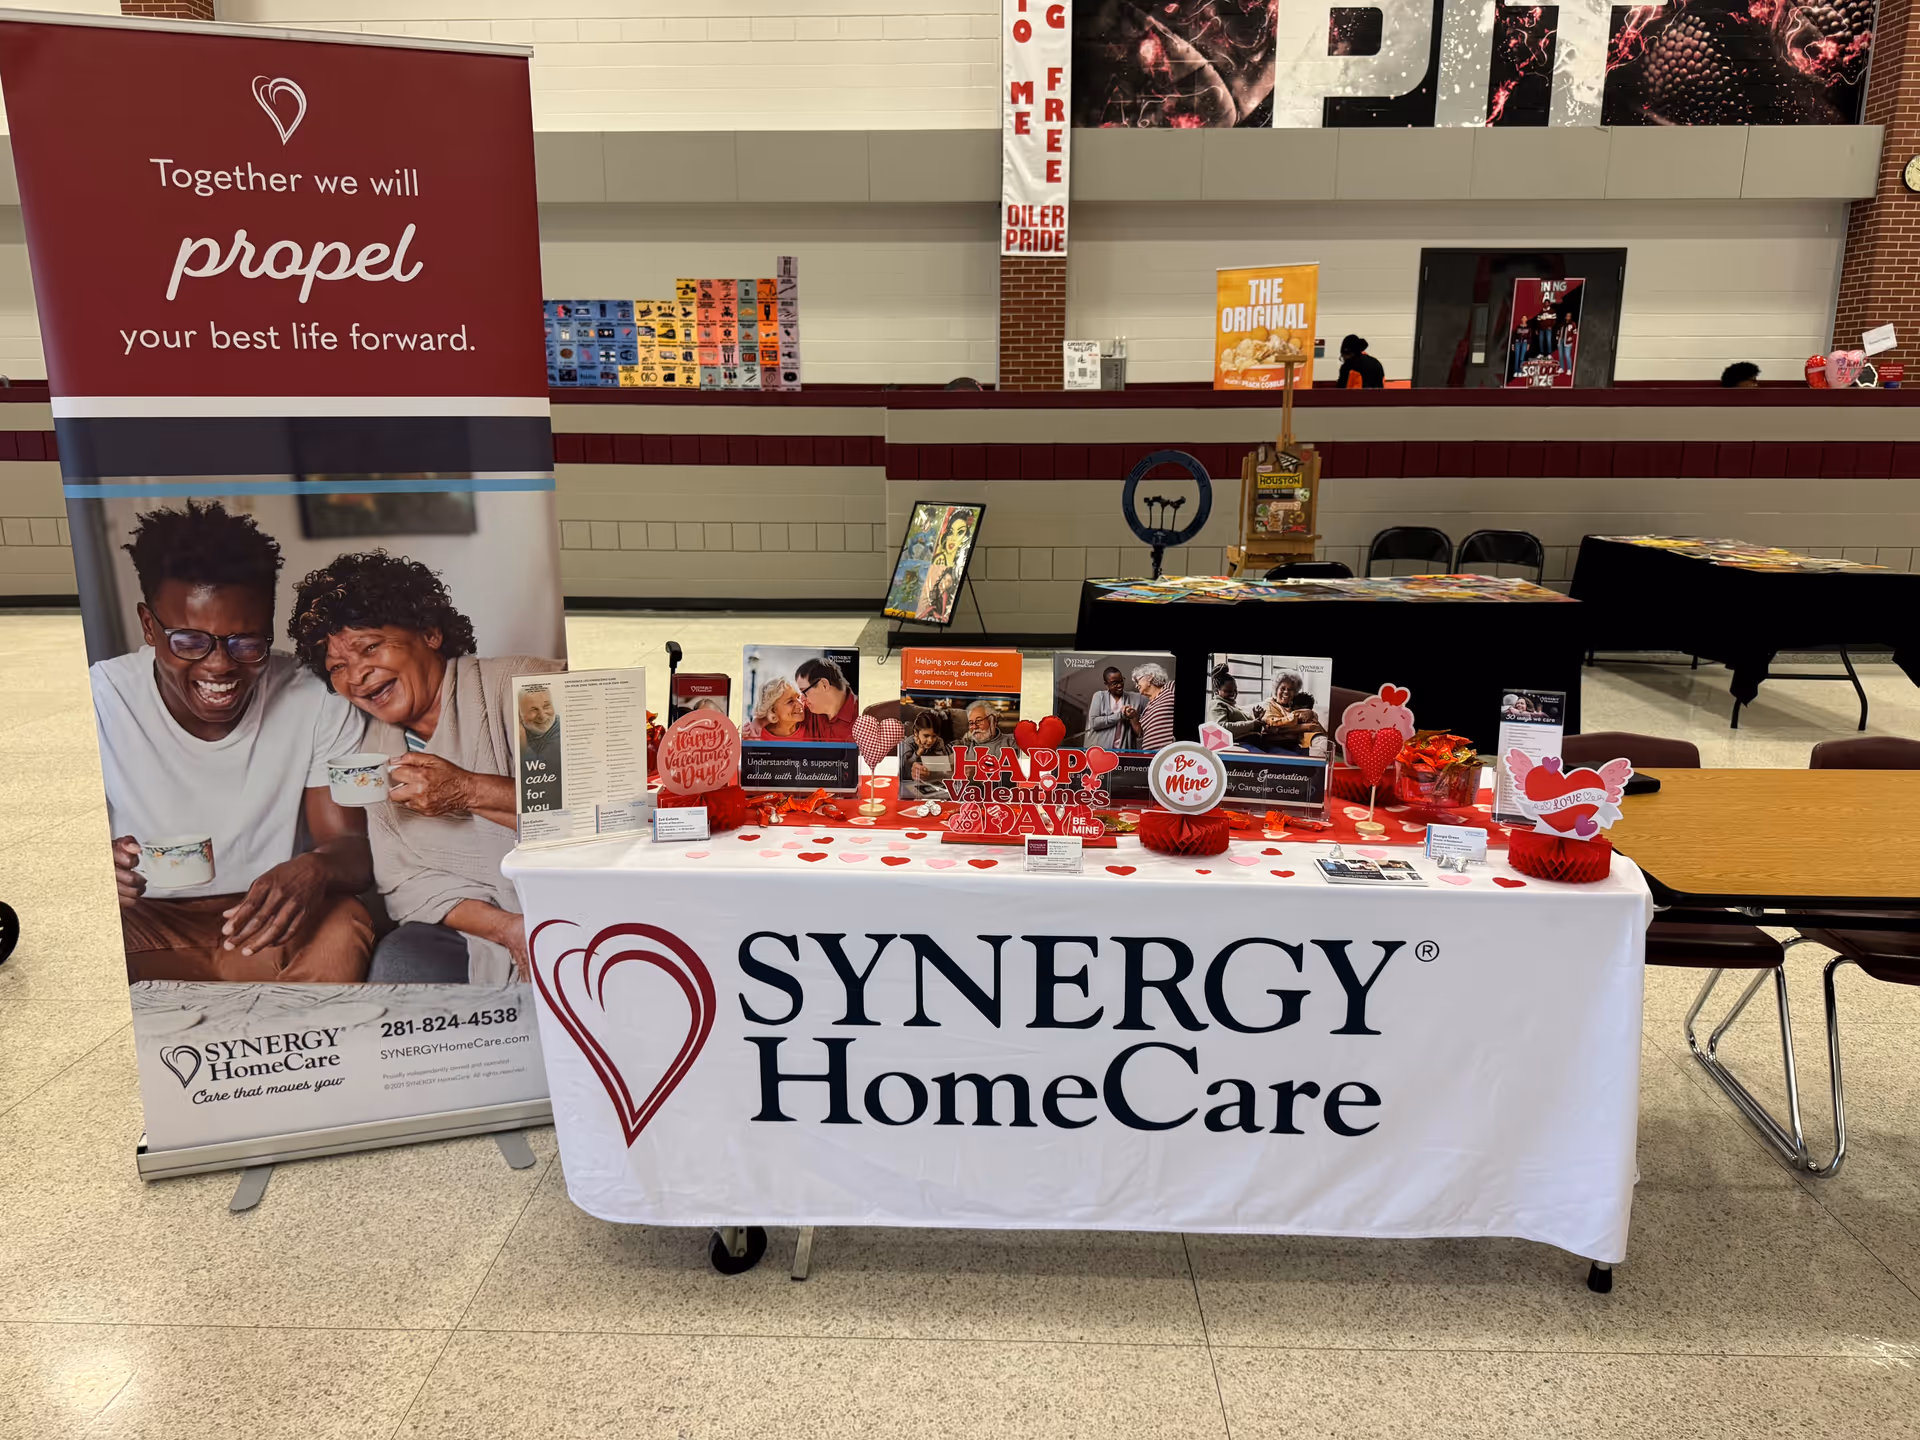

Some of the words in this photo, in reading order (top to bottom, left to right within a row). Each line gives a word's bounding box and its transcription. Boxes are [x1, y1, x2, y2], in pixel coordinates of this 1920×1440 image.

[1045, 67, 1065, 183] FREE
[150, 159, 303, 197] Together
[314, 175, 358, 195] we
[370, 168, 419, 197] will
[1007, 204, 1065, 228] OILER
[1005, 229, 1065, 253] PRIDE
[166, 223, 424, 304] propel
[1248, 278, 1283, 306] THE
[1221, 303, 1308, 333] ORIGINAL
[119, 329, 198, 355] your
[210, 321, 281, 350] best
[291, 322, 338, 350] life
[350, 322, 476, 351] forward.
[1260, 475, 1300, 486] HOUSTON
[915, 656, 942, 666] Helping
[943, 659, 959, 667] your
[960, 658, 982, 667] loved
[914, 668, 959, 677] experiencing
[960, 669, 993, 678] dementia
[954, 679, 968, 687] loss
[525, 760, 546, 771] We
[747, 758, 800, 768] Understanding
[802, 759, 808, 767] &
[810, 759, 849, 769] supporting
[1174, 754, 1197, 772] Be
[525, 773, 557, 784] care
[746, 772, 772, 780] adults
[774, 772, 792, 780] with
[794, 772, 838, 781] disabilities
[1166, 774, 1214, 795] Mine
[1257, 769, 1309, 783] Generation
[526, 789, 546, 799] for
[1238, 783, 1274, 793] Caregiver
[1276, 785, 1300, 795] Guide
[526, 803, 550, 813] you
[1553, 792, 1582, 811] LOVE
[1072, 816, 1086, 826] BE
[1072, 825, 1100, 835] MINE
[380, 1007, 518, 1038] 281-824-4538
[380, 1034, 530, 1060] SYNERGYHomeCare.com
[208, 1052, 341, 1082] HomeCare
[192, 1088, 231, 1105] Care
[233, 1086, 264, 1100] that
[266, 1079, 311, 1094] moves
[743, 1036, 1382, 1137] HomeCare
